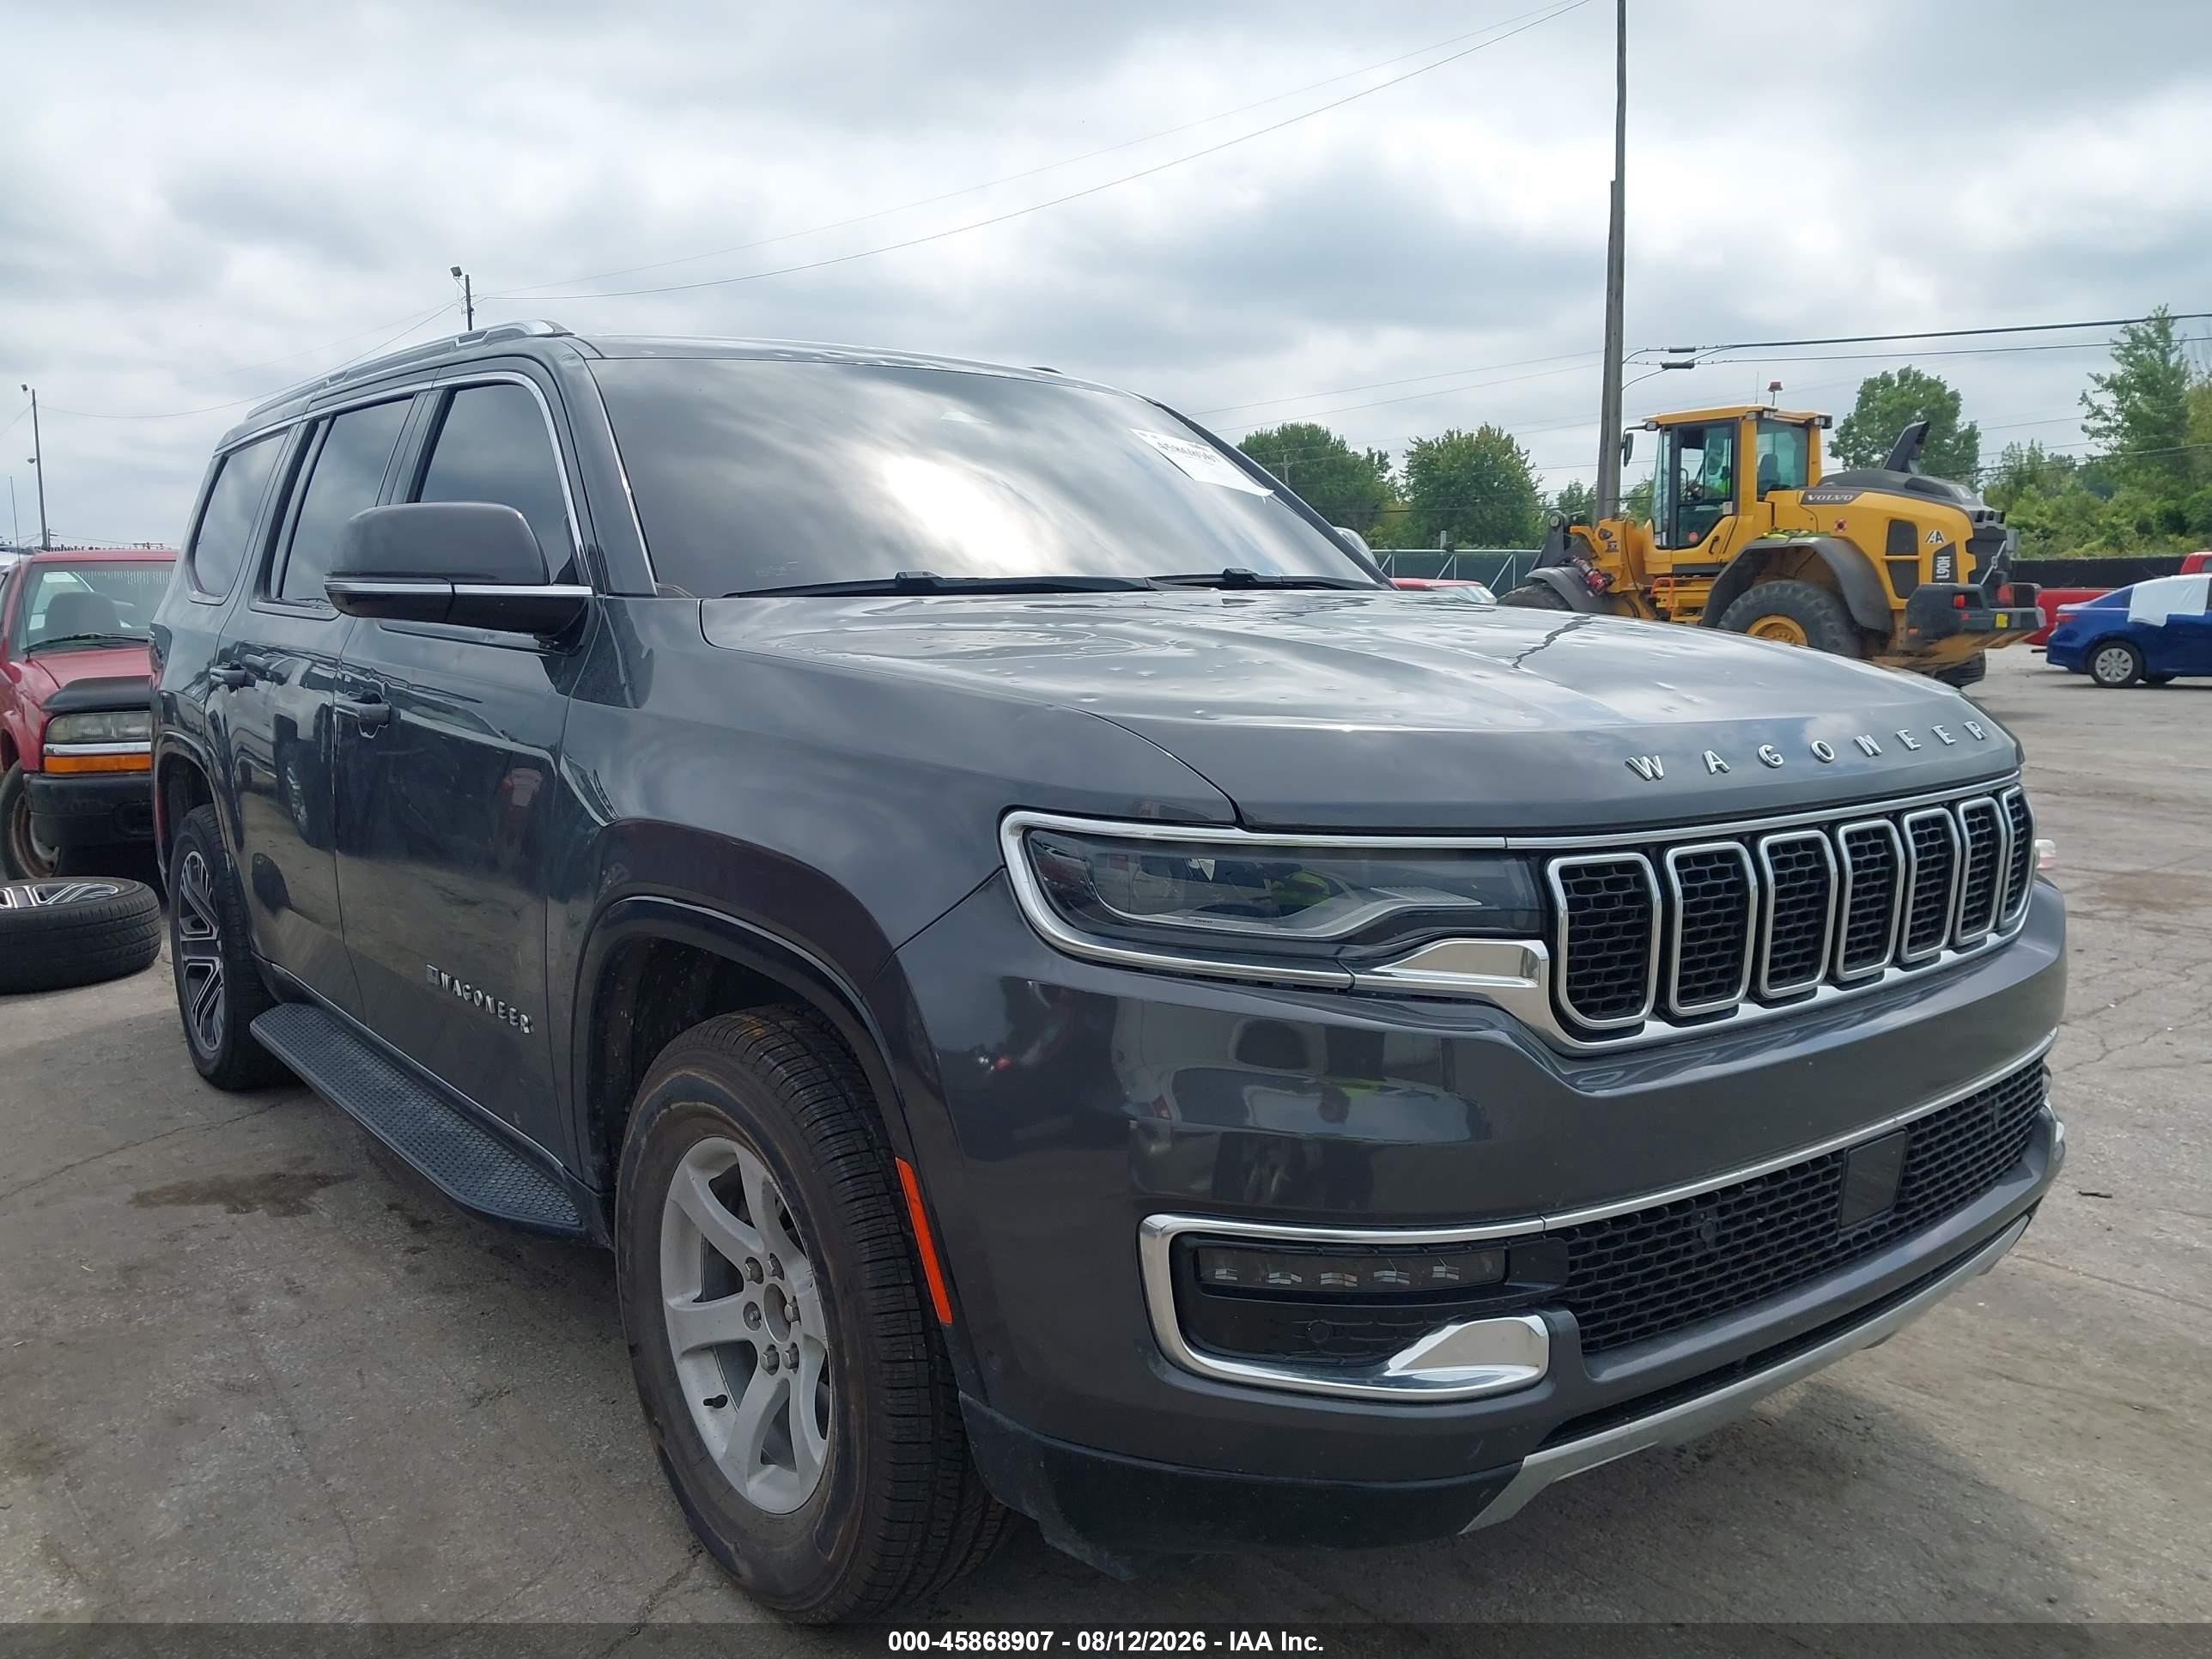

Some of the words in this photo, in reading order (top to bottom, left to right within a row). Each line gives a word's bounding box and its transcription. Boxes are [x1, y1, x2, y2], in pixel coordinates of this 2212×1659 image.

[1936, 556, 1951, 579] L90H
[1626, 720, 1990, 781] WAGONEER
[440, 971, 532, 1034] WAGONEER
